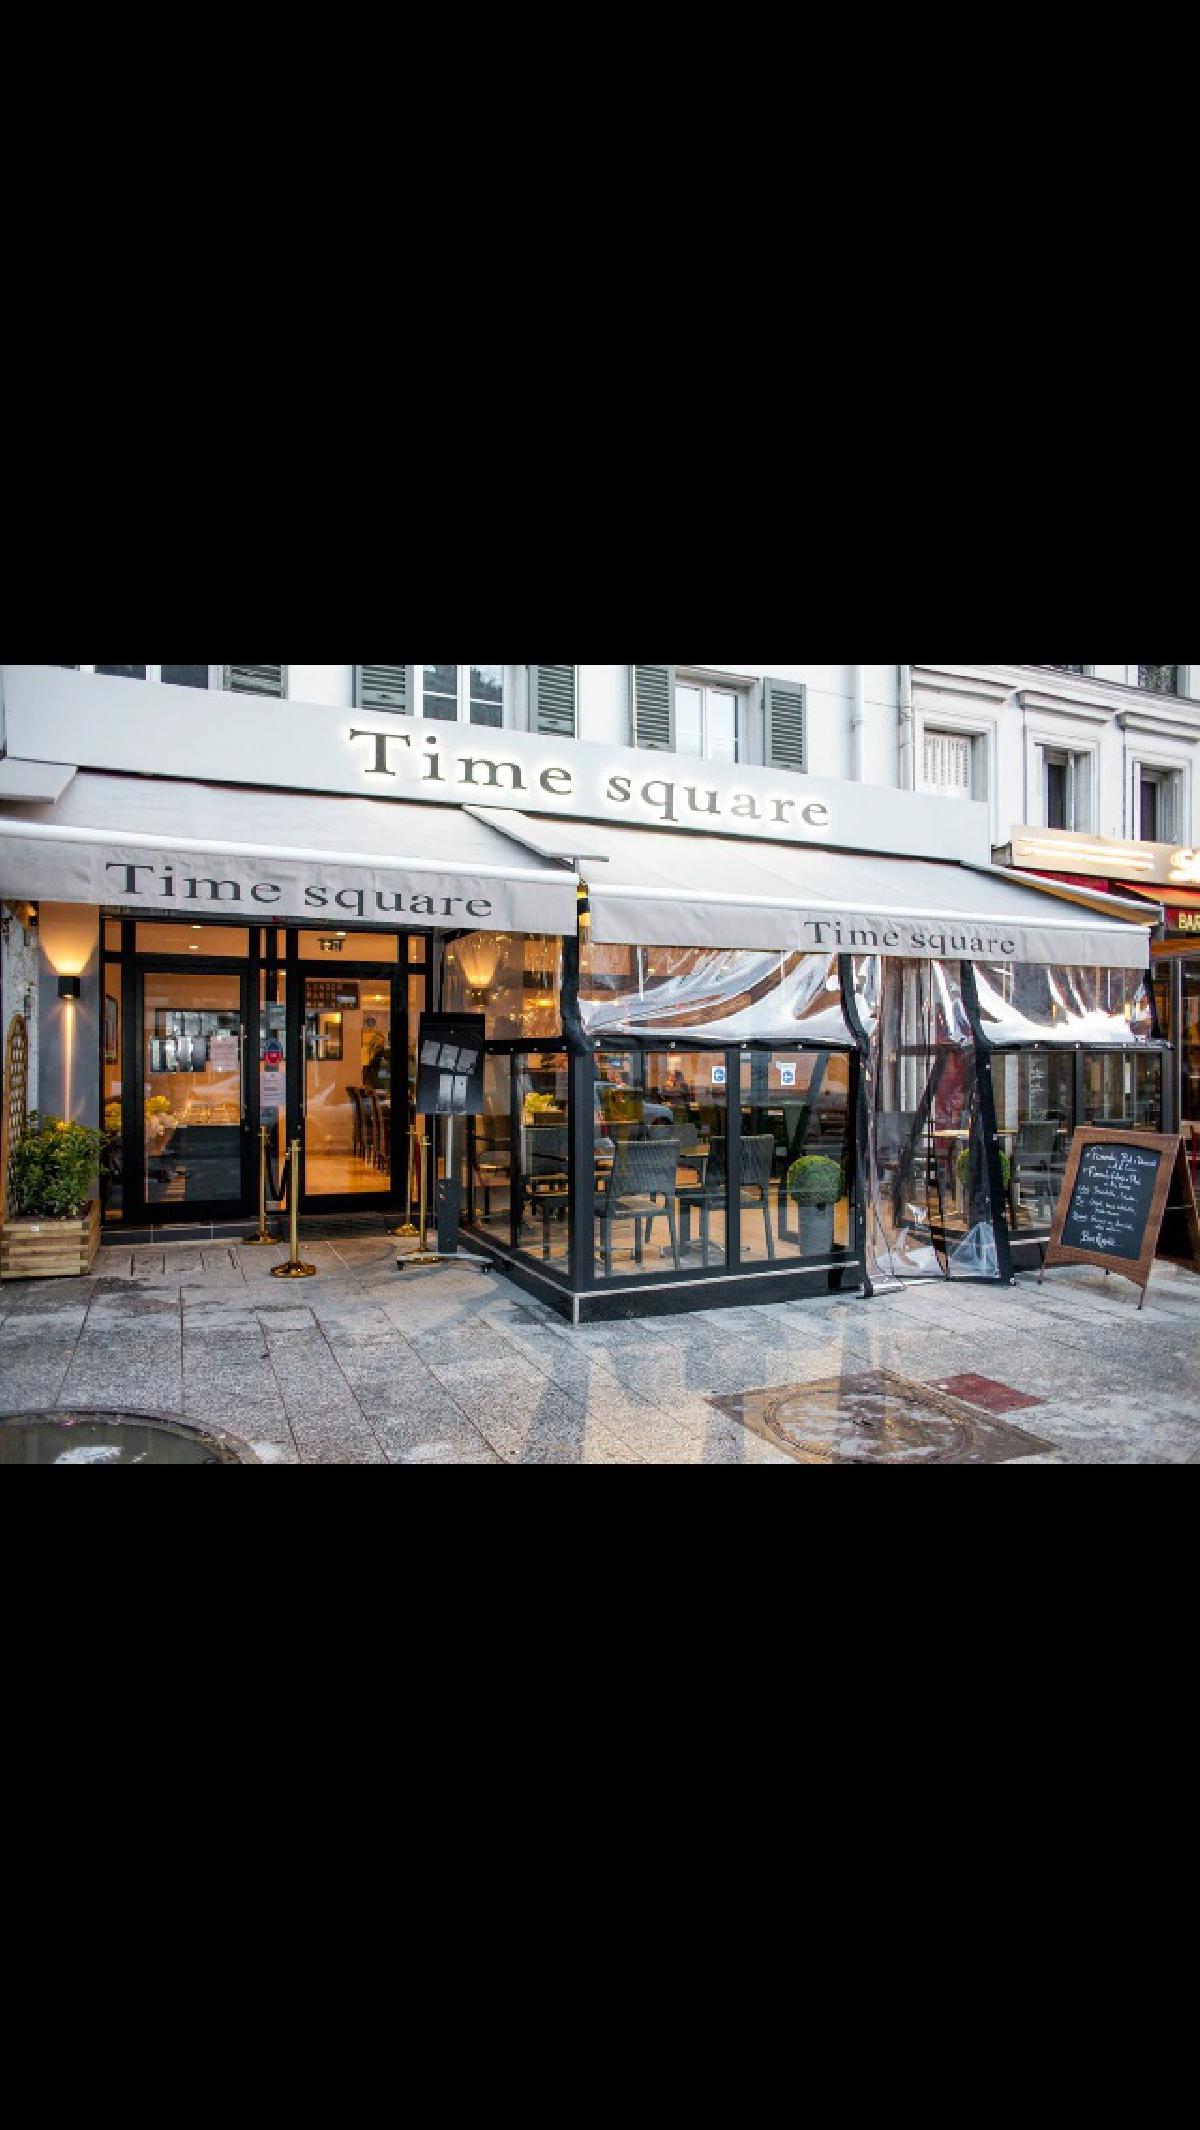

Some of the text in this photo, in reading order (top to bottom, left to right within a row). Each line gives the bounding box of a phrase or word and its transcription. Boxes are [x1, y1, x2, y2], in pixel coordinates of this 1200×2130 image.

[350, 728, 830, 828] Time square
[105, 862, 493, 917] Time square
[803, 920, 1016, 956] Time square
